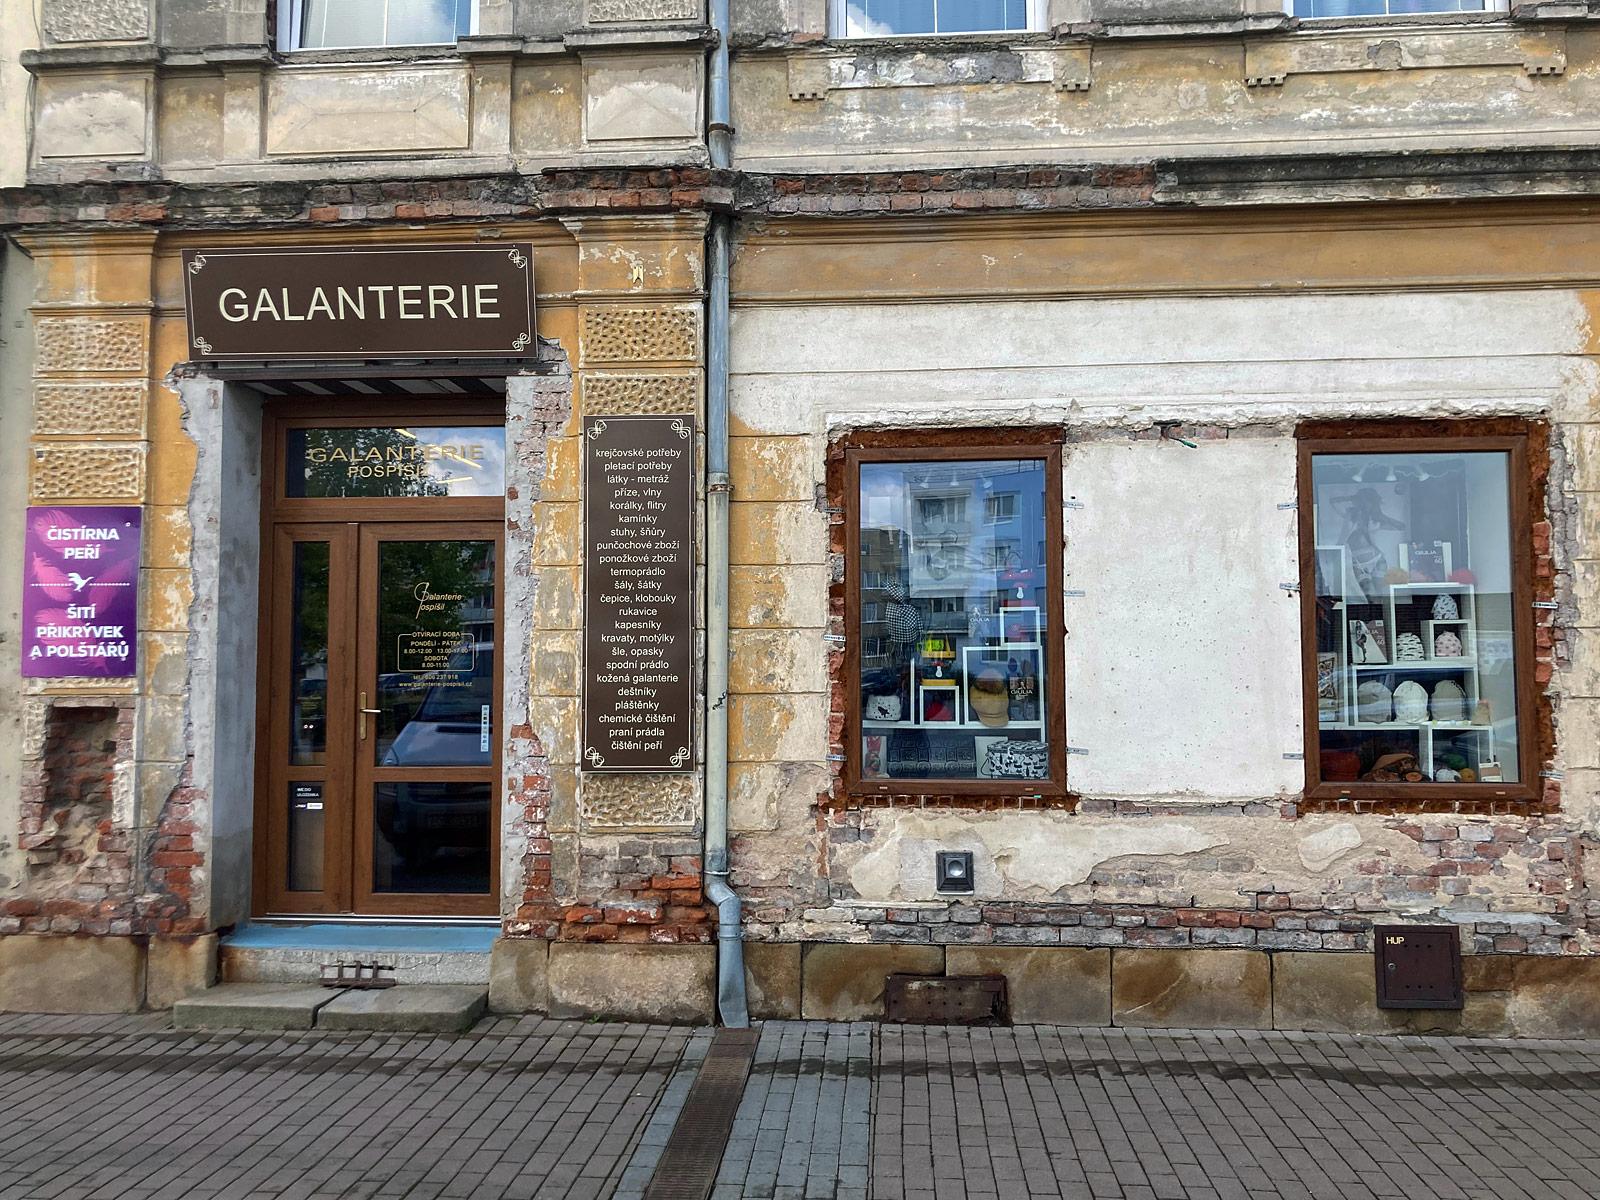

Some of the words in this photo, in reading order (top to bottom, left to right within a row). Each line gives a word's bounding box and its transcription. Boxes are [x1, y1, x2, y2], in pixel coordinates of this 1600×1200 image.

[218, 283, 501, 322] GALANTERIE
[309, 444, 484, 463] GALANTERIE
[595, 448, 644, 459] krejčovské
[646, 448, 682, 459] potřeby
[604, 462, 635, 472] pletací
[637, 462, 672, 471] potřeby
[607, 475, 628, 485] látky
[637, 475, 669, 483] metráž
[614, 488, 640, 498] příze,
[643, 488, 662, 498] vlny
[609, 501, 645, 511] korálky,
[647, 501, 667, 511] flitry
[618, 514, 657, 524] kamínky
[47, 525, 120, 541] ČISTÍRNA
[610, 527, 637, 538] stuhy,
[640, 527, 666, 538] šňůry
[596, 540, 652, 551] punčochové
[654, 540, 680, 549] zboží
[64, 544, 101, 559] PEŘÍ
[599, 553, 649, 564] ponožkové
[652, 553, 677, 562] zboží
[610, 567, 666, 577] termoprádlo
[614, 580, 635, 590] šály,
[637, 580, 662, 590] šátky
[600, 594, 633, 604] čepice,
[635, 594, 677, 604] klobouky
[67, 604, 96, 619] ŠITÍ
[619, 607, 658, 615] rukavice
[36, 623, 124, 638] PŘIKRÝVEK
[615, 620, 661, 631] kapesníky
[601, 634, 637, 644] kravaty,
[639, 634, 675, 644] motýlky
[31, 645, 42, 658] A
[46, 641, 129, 658] POLŠTÁŘŮ
[611, 647, 628, 657] šle,
[631, 648, 664, 657] opasky
[606, 660, 638, 670] spodní
[640, 660, 669, 670] prádlo
[596, 674, 630, 682] kožená
[632, 674, 679, 684] galanterie
[617, 687, 657, 697] deštníky
[615, 700, 659, 711] pláštěnky
[598, 714, 643, 723] chemické
[645, 713, 676, 723] čištění
[609, 727, 633, 737] praní
[635, 727, 665, 737] prádla
[611, 741, 642, 750] čištění
[644, 741, 663, 751] peří
[1386, 936, 1405, 944] HUP
